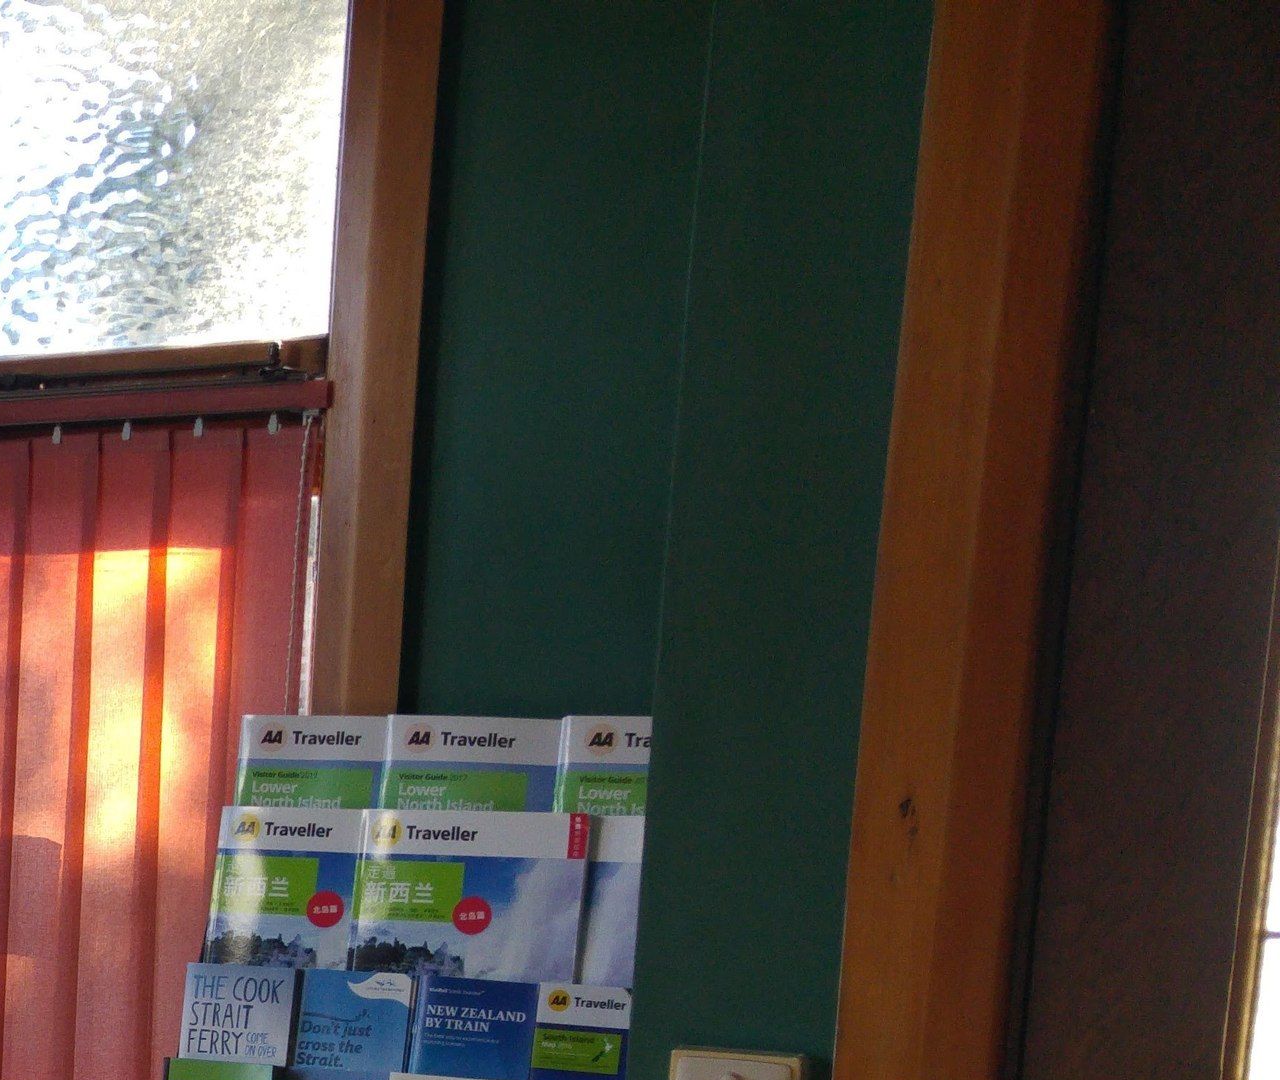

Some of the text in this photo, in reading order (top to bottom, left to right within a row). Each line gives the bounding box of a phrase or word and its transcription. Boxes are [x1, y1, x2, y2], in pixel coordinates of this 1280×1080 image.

[261, 730, 362, 747] AA Traveller
[408, 731, 517, 749] AA Traveller
[252, 782, 298, 795] Lower
[399, 785, 447, 798] Lower
[579, 788, 631, 801] Lower
[406, 825, 478, 842] Traveller
[365, 881, 435, 904] 新西兰
[194, 976, 285, 1004] THE COOK
[550, 995, 627, 1012] AA Traveller
[190, 1002, 254, 1030] STRAIT
[427, 1004, 527, 1024] NEW ZEALAND
[425, 1018, 491, 1034] BY TRAIN
